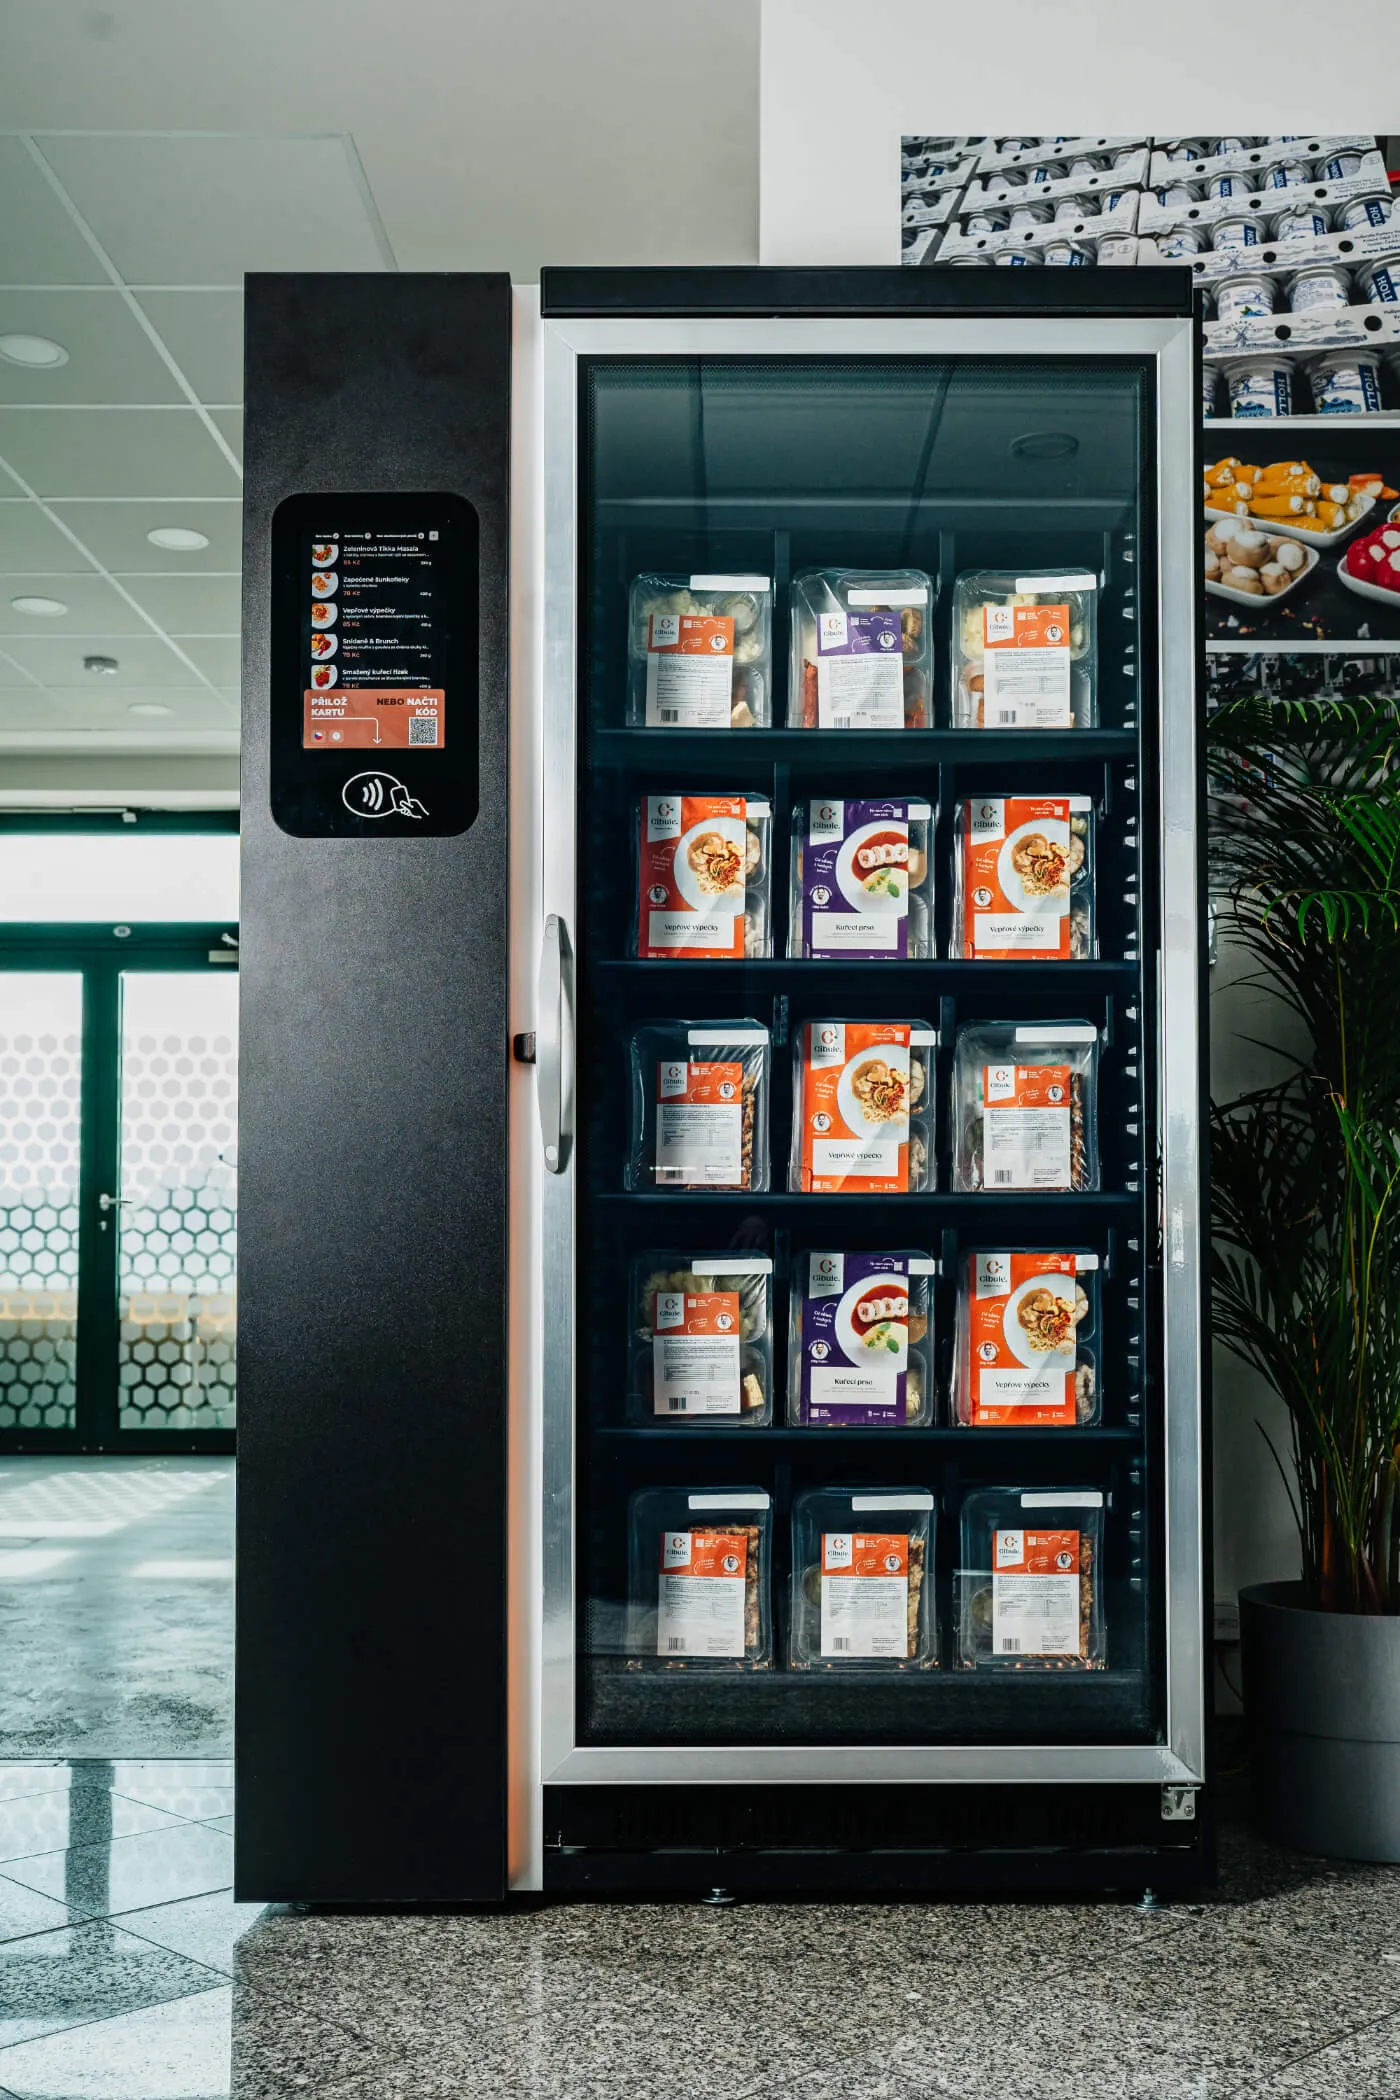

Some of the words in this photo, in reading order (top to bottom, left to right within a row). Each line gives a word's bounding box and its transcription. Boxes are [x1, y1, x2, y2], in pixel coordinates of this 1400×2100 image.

[311, 696, 348, 706] PŘILOŽ
[407, 696, 438, 706] NAČTI
[416, 706, 438, 716] KÓD
